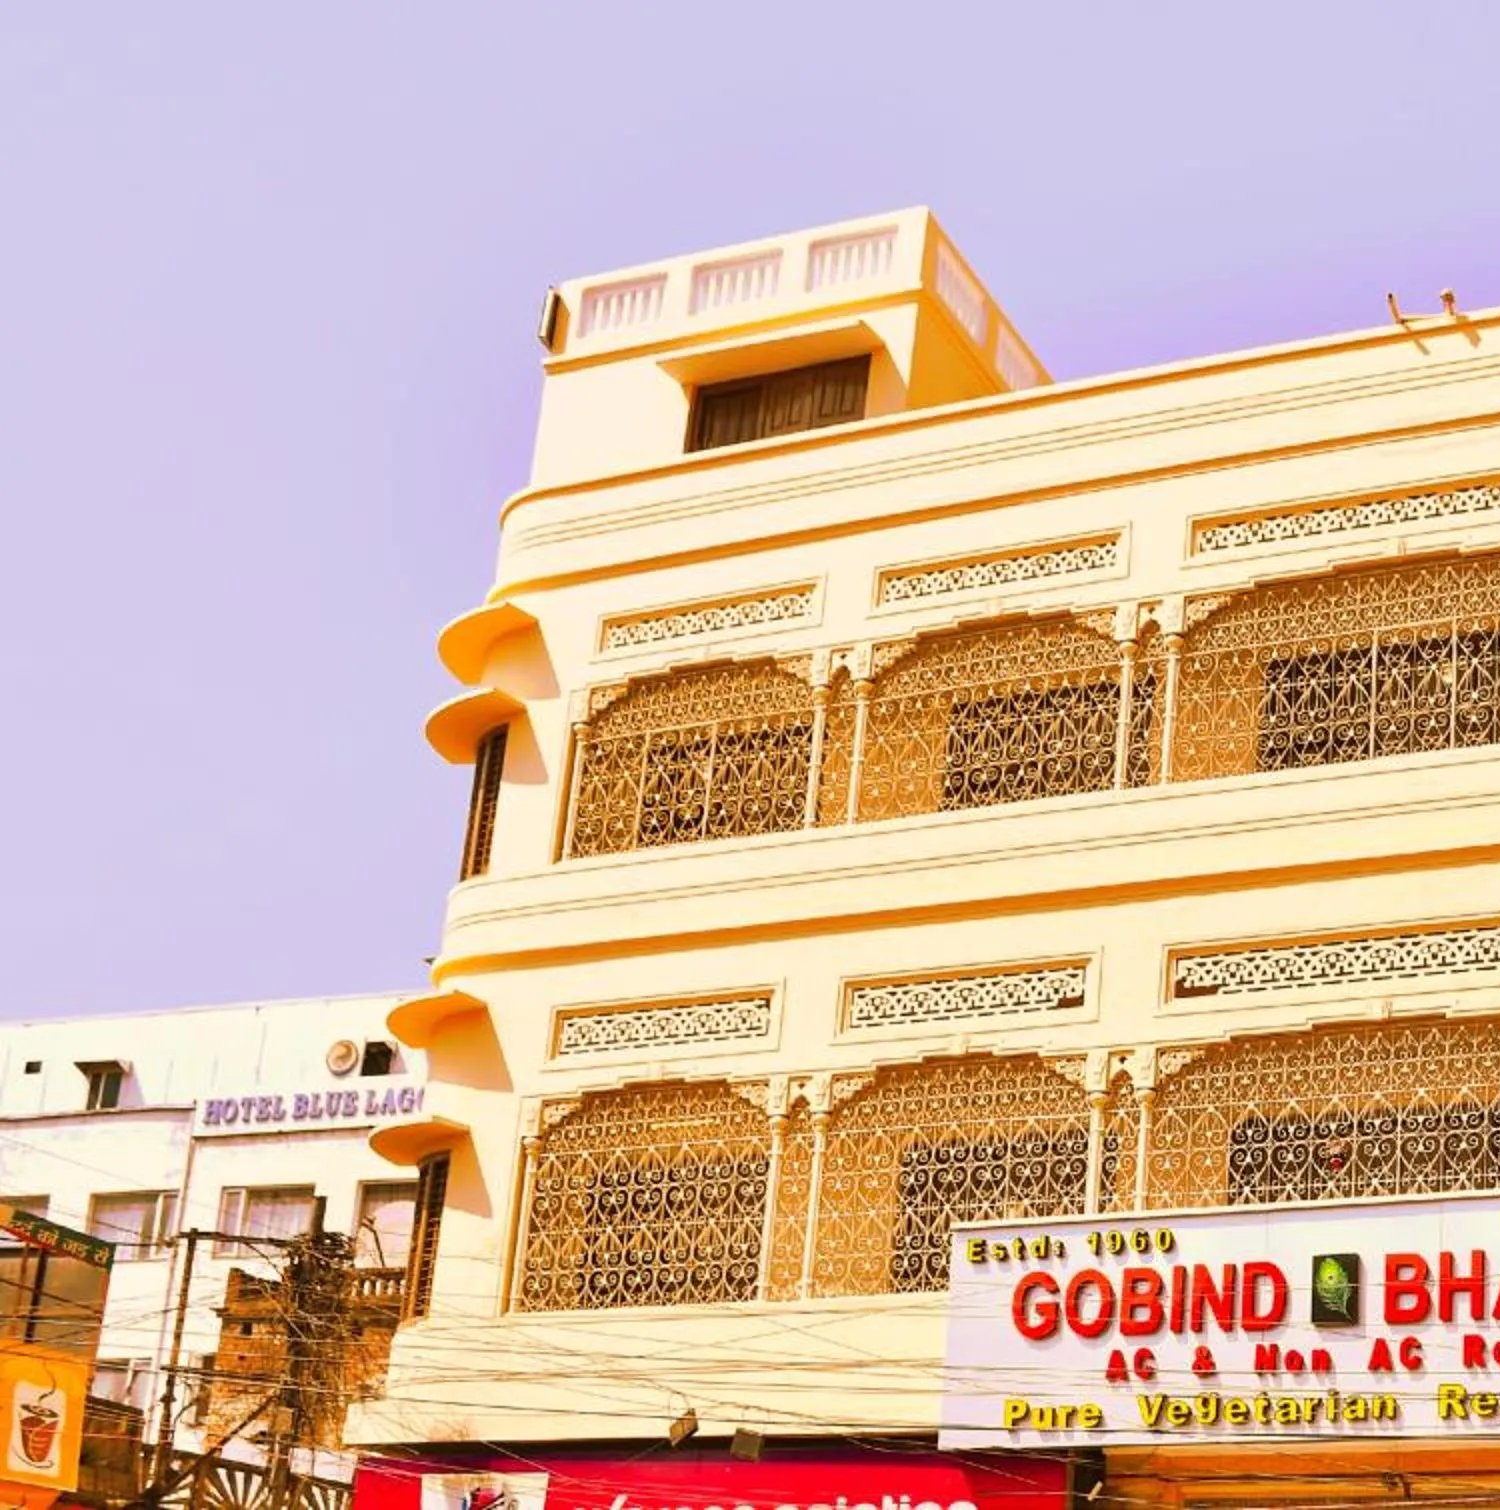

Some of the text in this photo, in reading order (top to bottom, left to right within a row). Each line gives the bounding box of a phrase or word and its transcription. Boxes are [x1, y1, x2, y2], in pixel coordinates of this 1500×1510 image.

[203, 1096, 287, 1126] HOTEL
[292, 1091, 359, 1121] BLUE
[966, 1228, 1177, 1264] Estd: 1960
[1011, 1260, 1291, 1341] GOBIND
[1105, 1347, 1157, 1382] AC
[1191, 1345, 1216, 1378] &
[1254, 1342, 1333, 1375] Non
[1368, 1336, 1423, 1372] AC
[1003, 1398, 1103, 1431] Pure
[1136, 1389, 1398, 1427] Vegetarian
